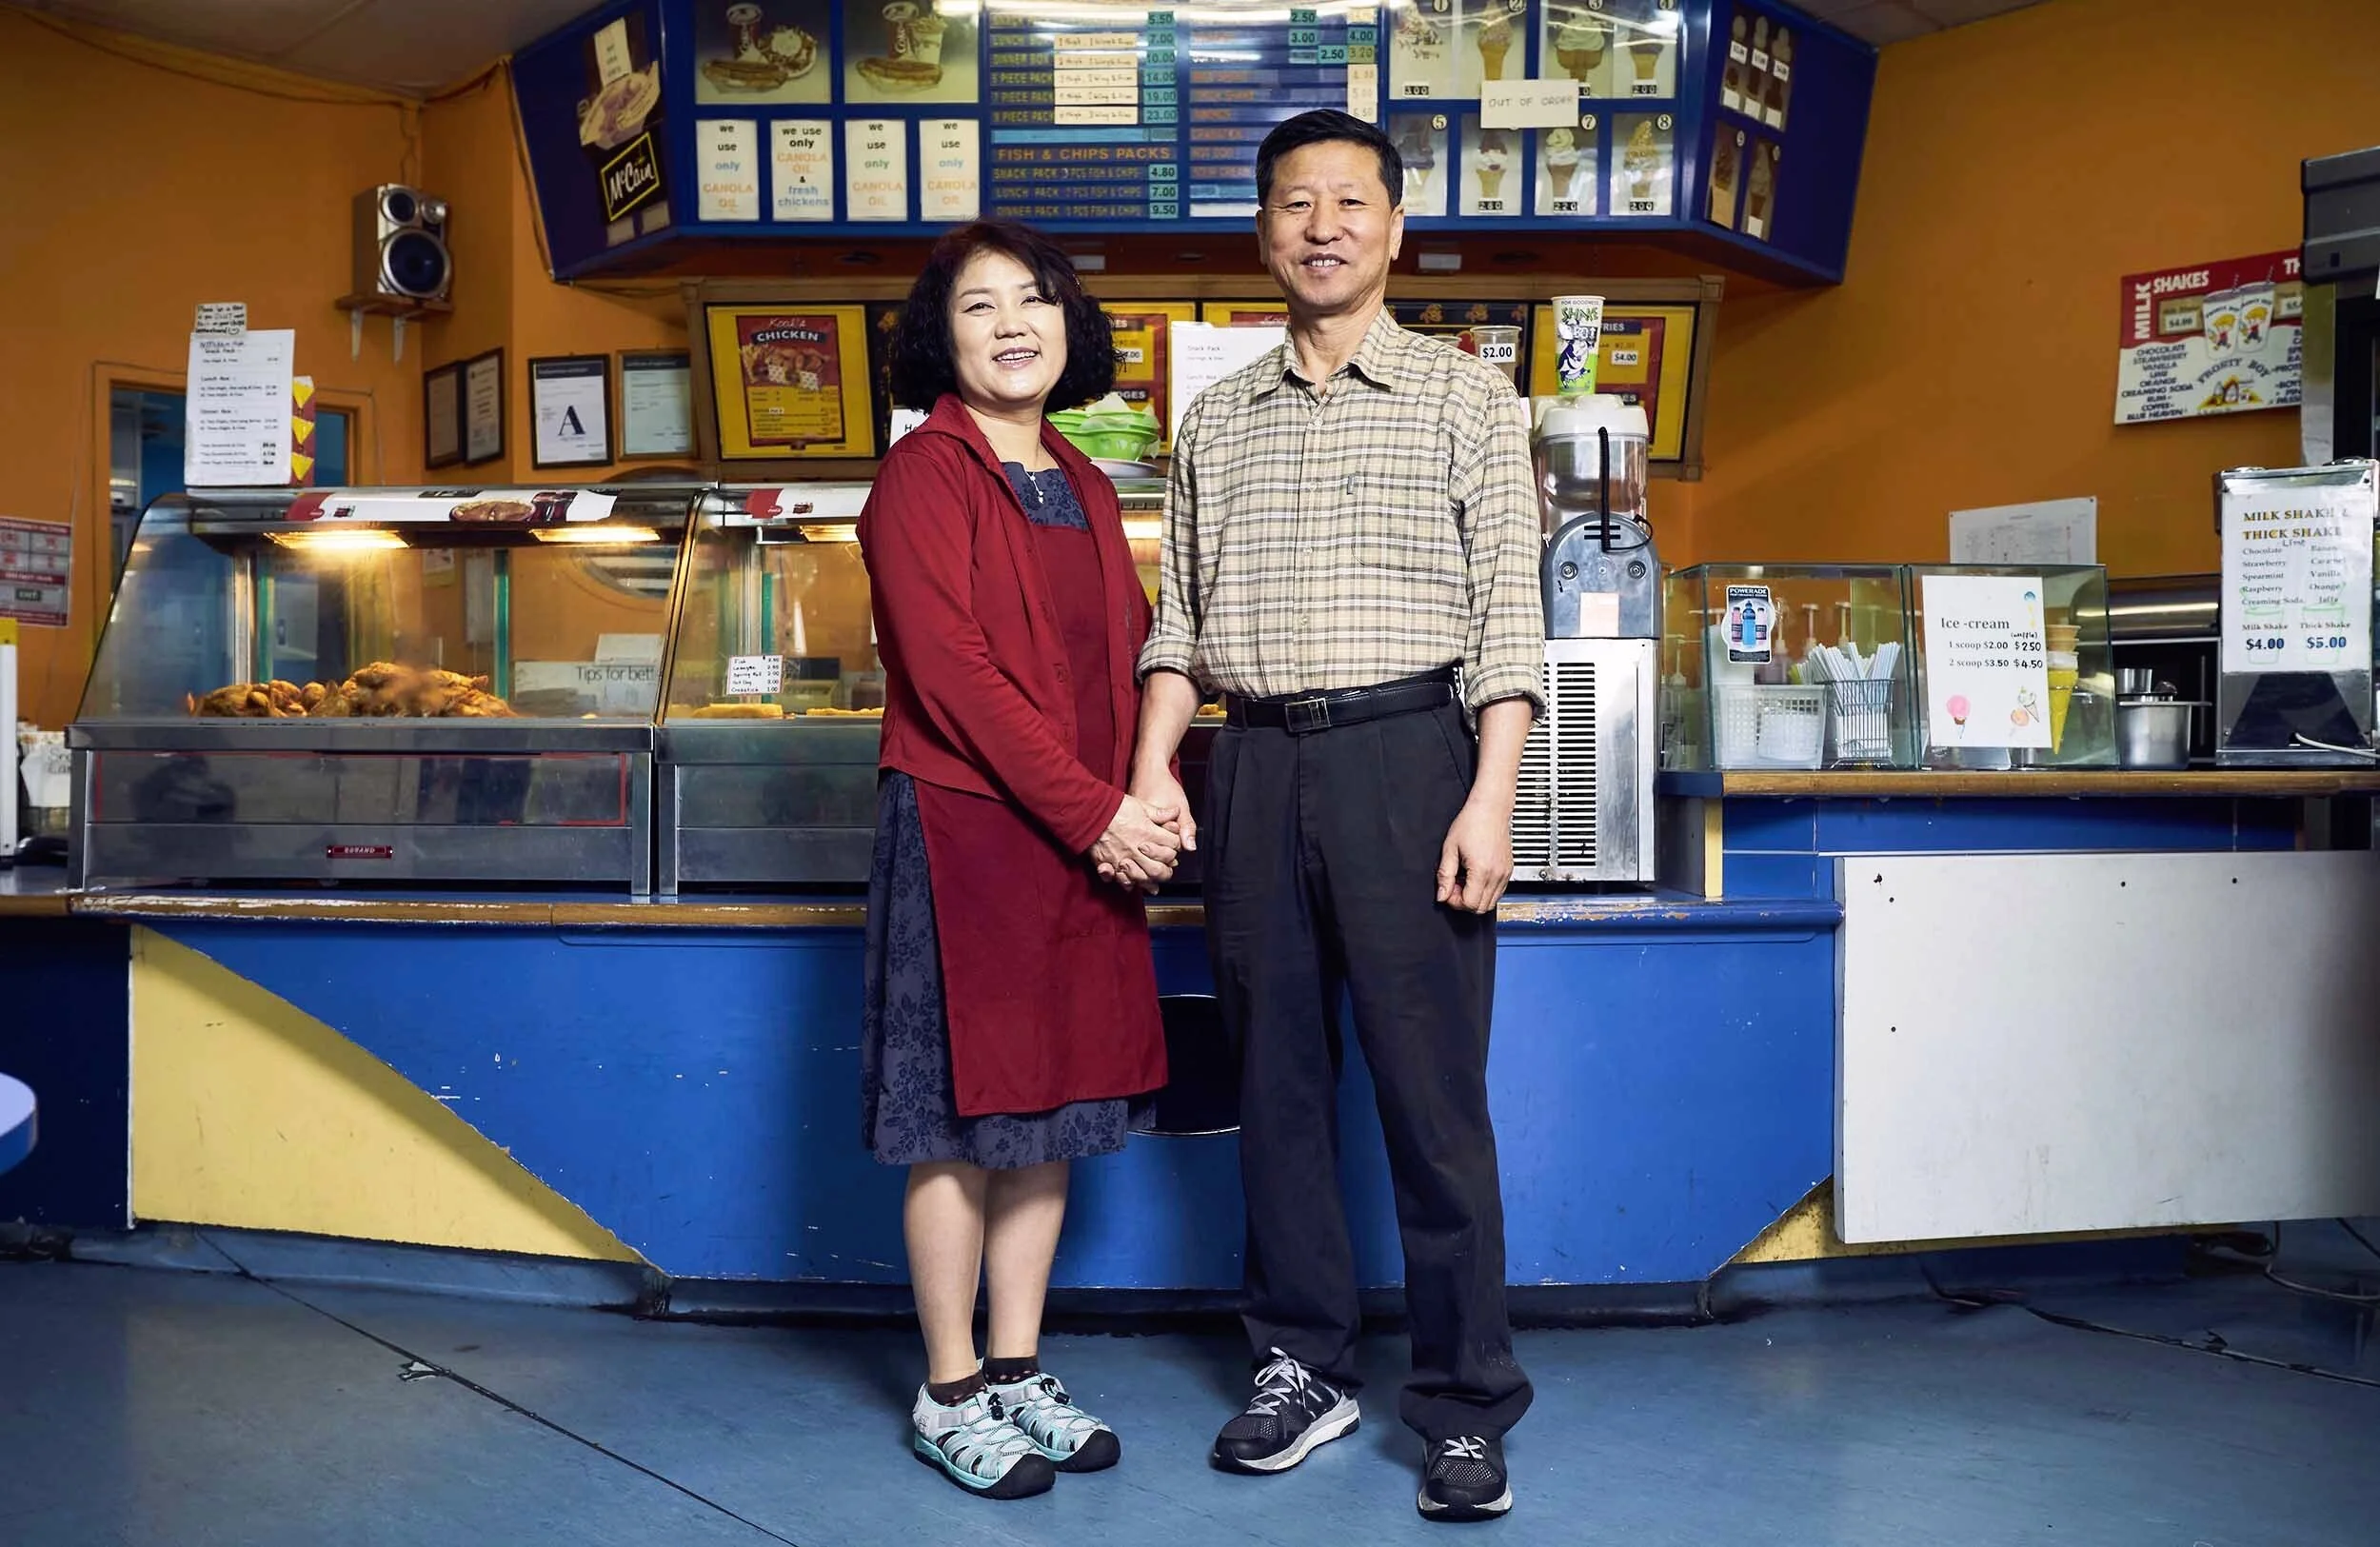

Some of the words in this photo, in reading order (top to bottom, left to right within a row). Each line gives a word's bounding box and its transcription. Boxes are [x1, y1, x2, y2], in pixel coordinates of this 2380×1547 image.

[1148, 12, 1173, 25] 5.50
[1291, 12, 1315, 23] 2.50
[1150, 33, 1174, 45] 7.00
[1291, 32, 1315, 43] 3.00
[1350, 30, 1373, 41] 4.00
[1146, 52, 1176, 64] 10.00
[1320, 50, 1344, 60] 2.50
[1146, 71, 1176, 82] 14.00
[1633, 85, 1656, 93] 200
[1146, 90, 1176, 101] 19.00
[1488, 98, 1510, 108] OUT
[1519, 97, 1533, 107] OF
[1146, 109, 1176, 120] 23.00
[720, 124, 734, 132] we
[782, 127, 797, 135] we
[803, 127, 822, 135] use
[868, 123, 883, 131] we
[717, 143, 737, 151] use
[789, 138, 815, 149] only
[866, 141, 886, 149] use
[941, 140, 961, 149] use
[777, 152, 827, 162] CANOLA
[997, 149, 1034, 161] FISH
[1041, 149, 1052, 160] &
[1060, 149, 1109, 160] CHIPS
[1116, 148, 1171, 160] PACKS
[715, 161, 741, 171] only
[864, 159, 890, 169] only
[939, 158, 963, 169] only
[792, 165, 811, 174] OIL
[1151, 168, 1175, 177] 4.80
[608, 161, 654, 208] McCain
[703, 183, 754, 193] CANOLA
[853, 181, 902, 191] CANOLA
[927, 181, 977, 190] CANOLA
[788, 186, 818, 195] fresh
[1152, 188, 1176, 197] 7.00
[778, 198, 829, 207] chickens
[1152, 205, 1176, 215] 9.50
[2153, 270, 2209, 293] SHAKES
[2134, 281, 2152, 339] MILK
[1603, 323, 1625, 331] RIES
[757, 330, 819, 343] CHICKEN
[1482, 347, 1513, 358] $2.00
[1615, 352, 1636, 362] $4.00
[2249, 359, 2271, 378] BOY
[2121, 387, 2167, 398] CREAMING
[2127, 412, 2146, 421] BLUE
[2149, 408, 2184, 418] HEAVEN
[558, 405, 585, 436] A
[2243, 511, 2280, 522] MILK
[2243, 529, 2289, 540] THICK
[2292, 526, 2342, 538] SHAKE
[2242, 573, 2284, 582] Spearmint
[2241, 597, 2281, 605] Creaming
[1941, 617, 1960, 628] Ice
[2326, 621, 2350, 629] Shake
[1955, 642, 1981, 650] scoop
[1984, 641, 2009, 649] $2.00
[2246, 637, 2285, 651] $4.00
[2307, 636, 2347, 649] $5.00
[1956, 660, 1982, 668] scoop
[1985, 659, 2010, 667] $3.50
[2013, 659, 2043, 668] $4.50
[575, 666, 603, 684] Tips
[606, 666, 625, 681] for
[628, 666, 657, 681] bett
